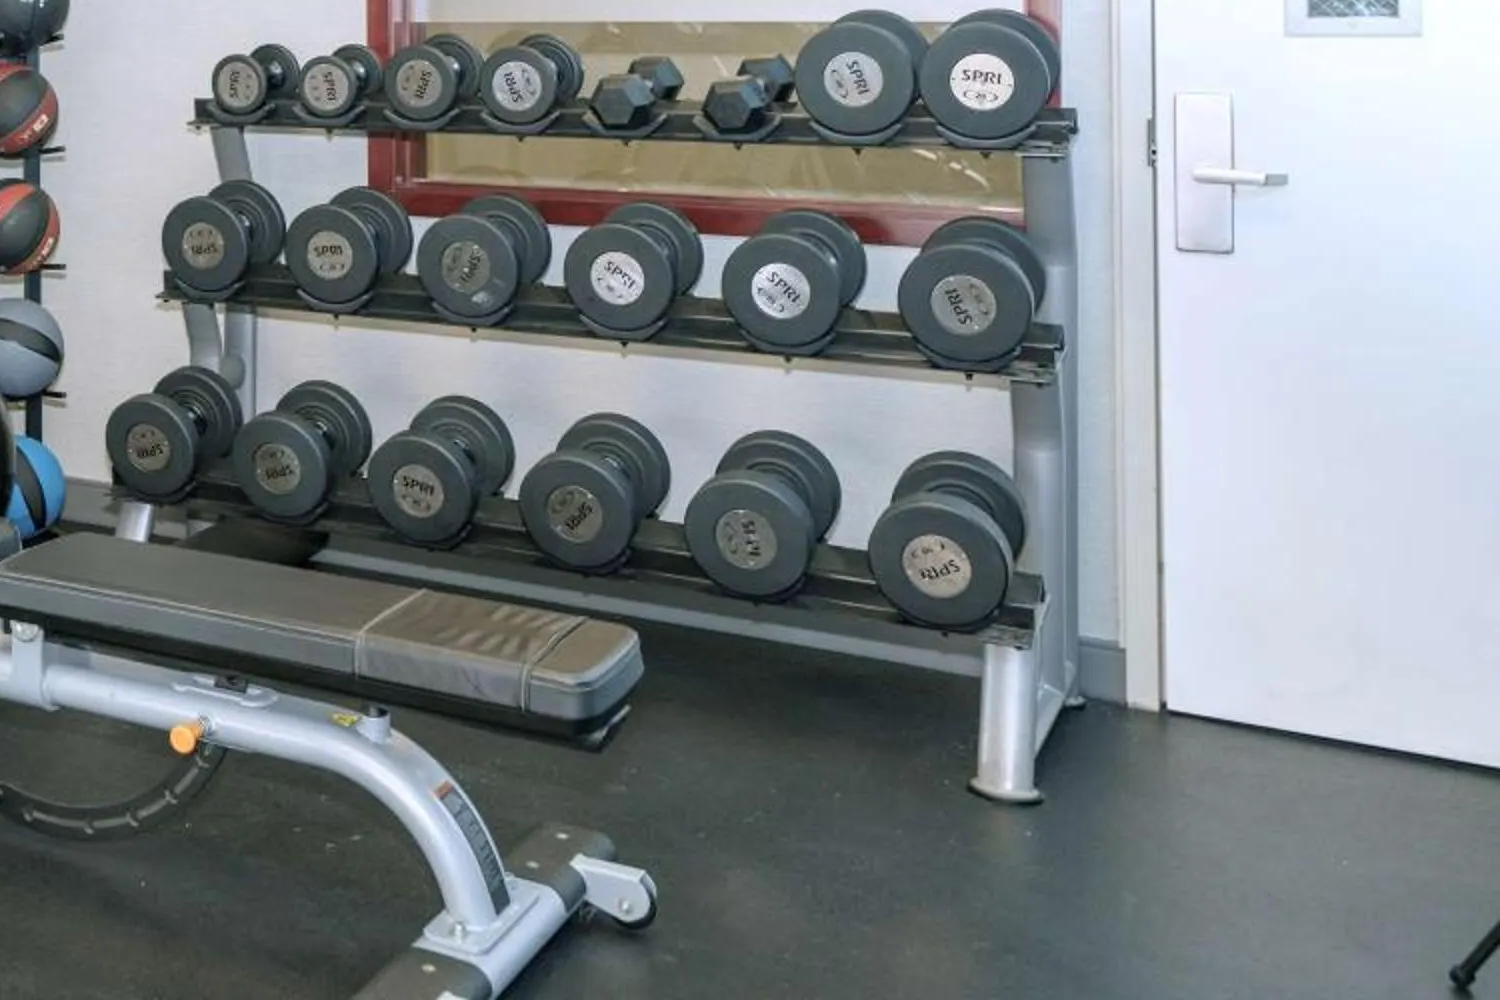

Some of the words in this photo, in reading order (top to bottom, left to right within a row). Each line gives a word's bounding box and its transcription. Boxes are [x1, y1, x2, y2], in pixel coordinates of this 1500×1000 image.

[323, 71, 335, 101] SPRI
[415, 70, 432, 99] SPRI
[504, 72, 523, 103] SPRI
[846, 61, 869, 95] SPRI
[962, 69, 1002, 85] SPRI
[190, 243, 218, 255] SPRI
[604, 261, 636, 289] SPRI
[766, 271, 800, 303] SPRI
[945, 288, 973, 325] SPRI
[402, 476, 435, 496] SPRI
[565, 502, 593, 529] SPRI
[919, 559, 961, 580] SPRI
